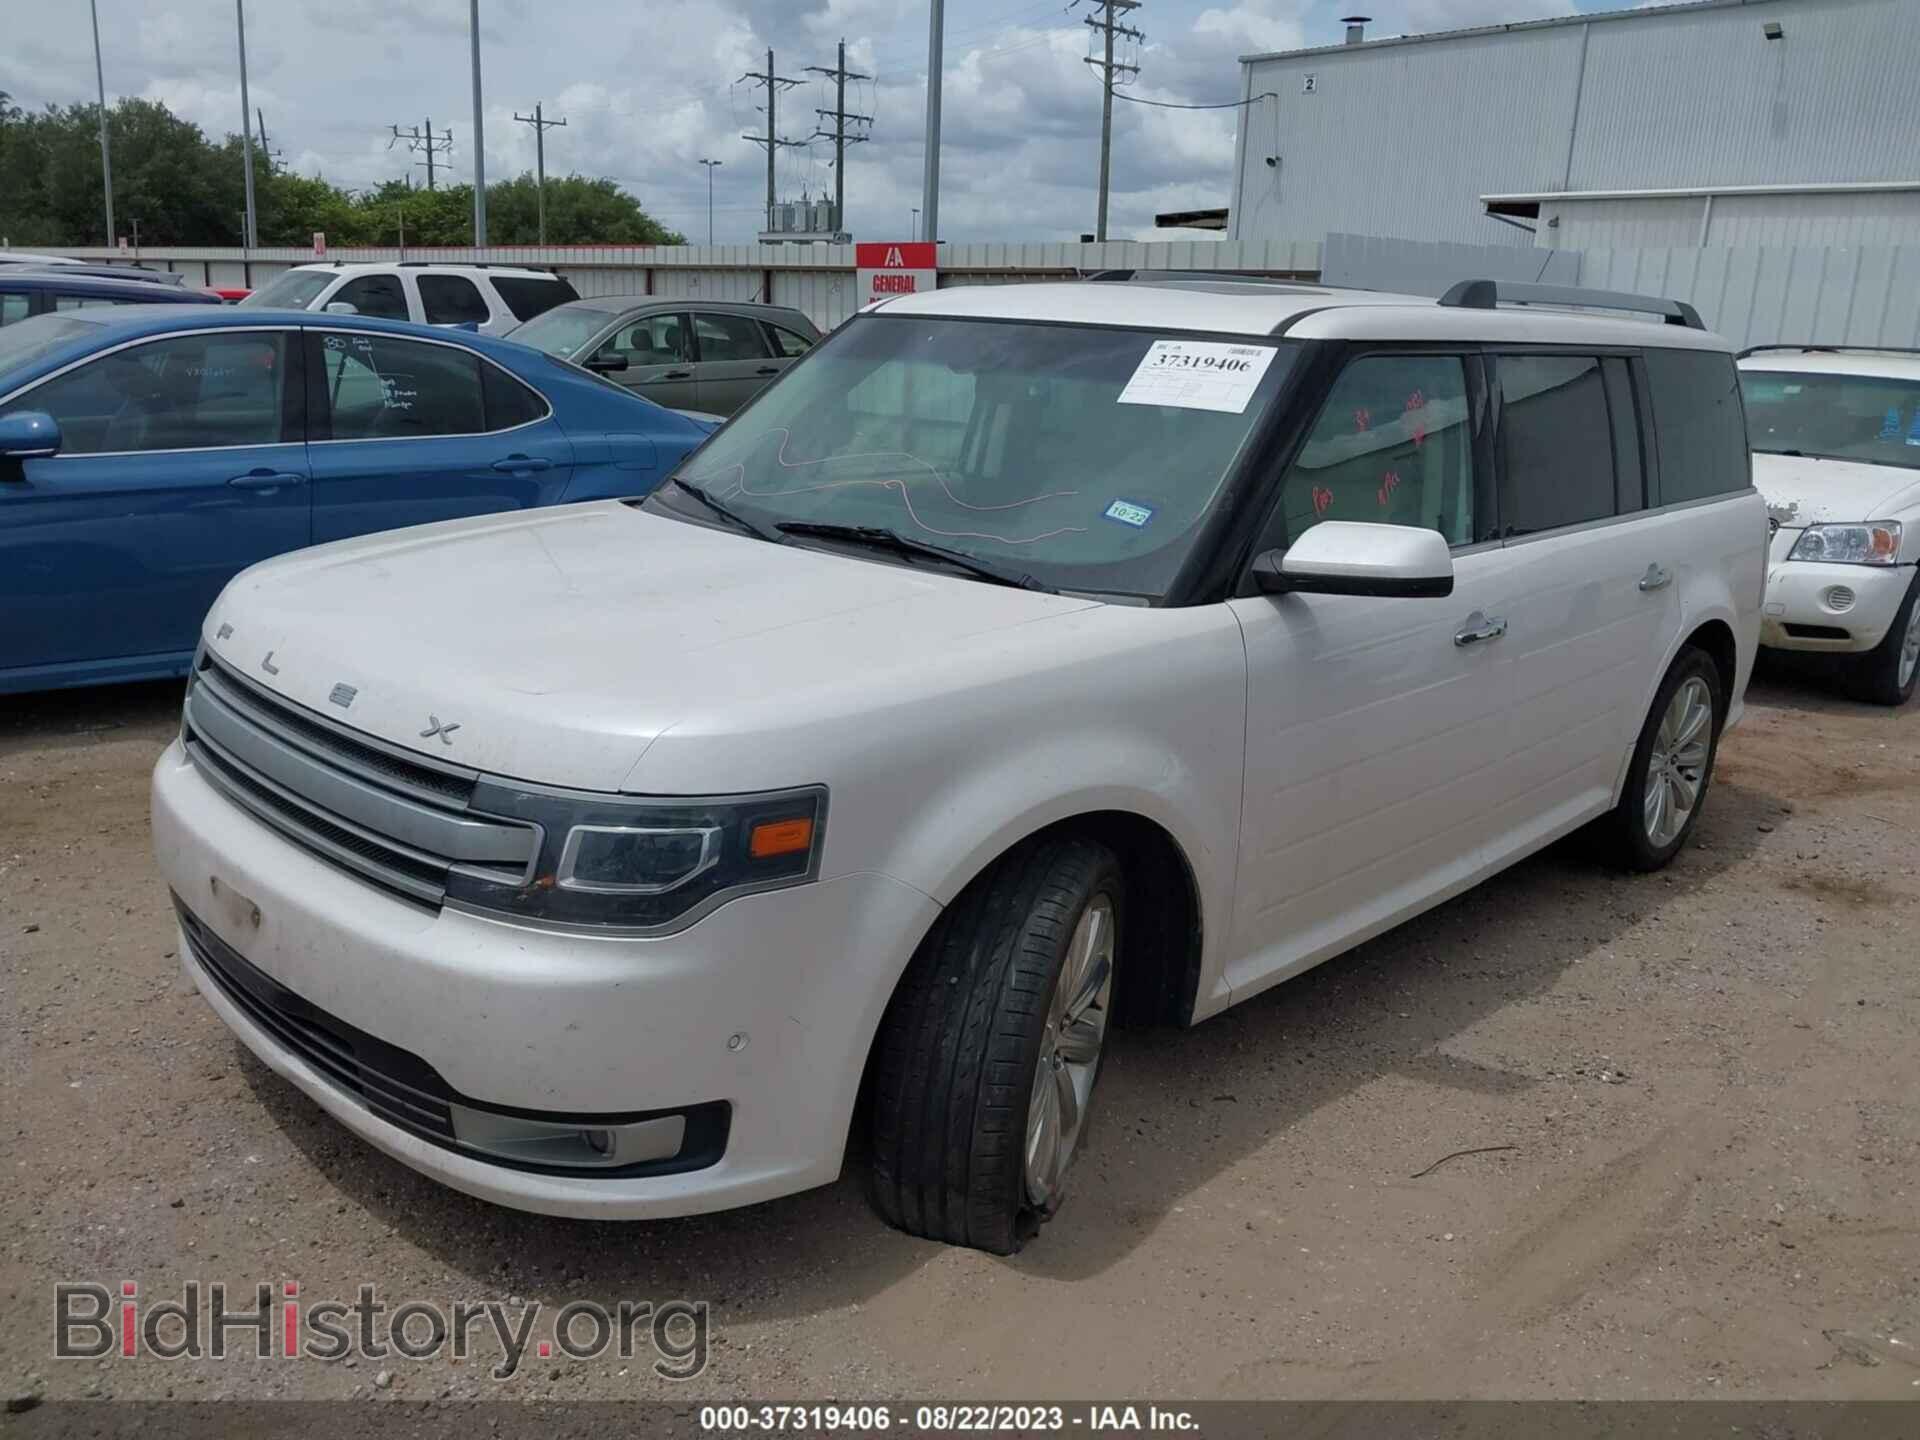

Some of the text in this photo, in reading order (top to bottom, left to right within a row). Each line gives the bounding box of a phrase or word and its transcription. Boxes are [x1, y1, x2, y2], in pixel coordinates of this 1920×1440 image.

[1305, 78, 1314, 90] 2
[872, 274, 916, 293] GENERAL
[1152, 353, 1251, 372] 37319406
